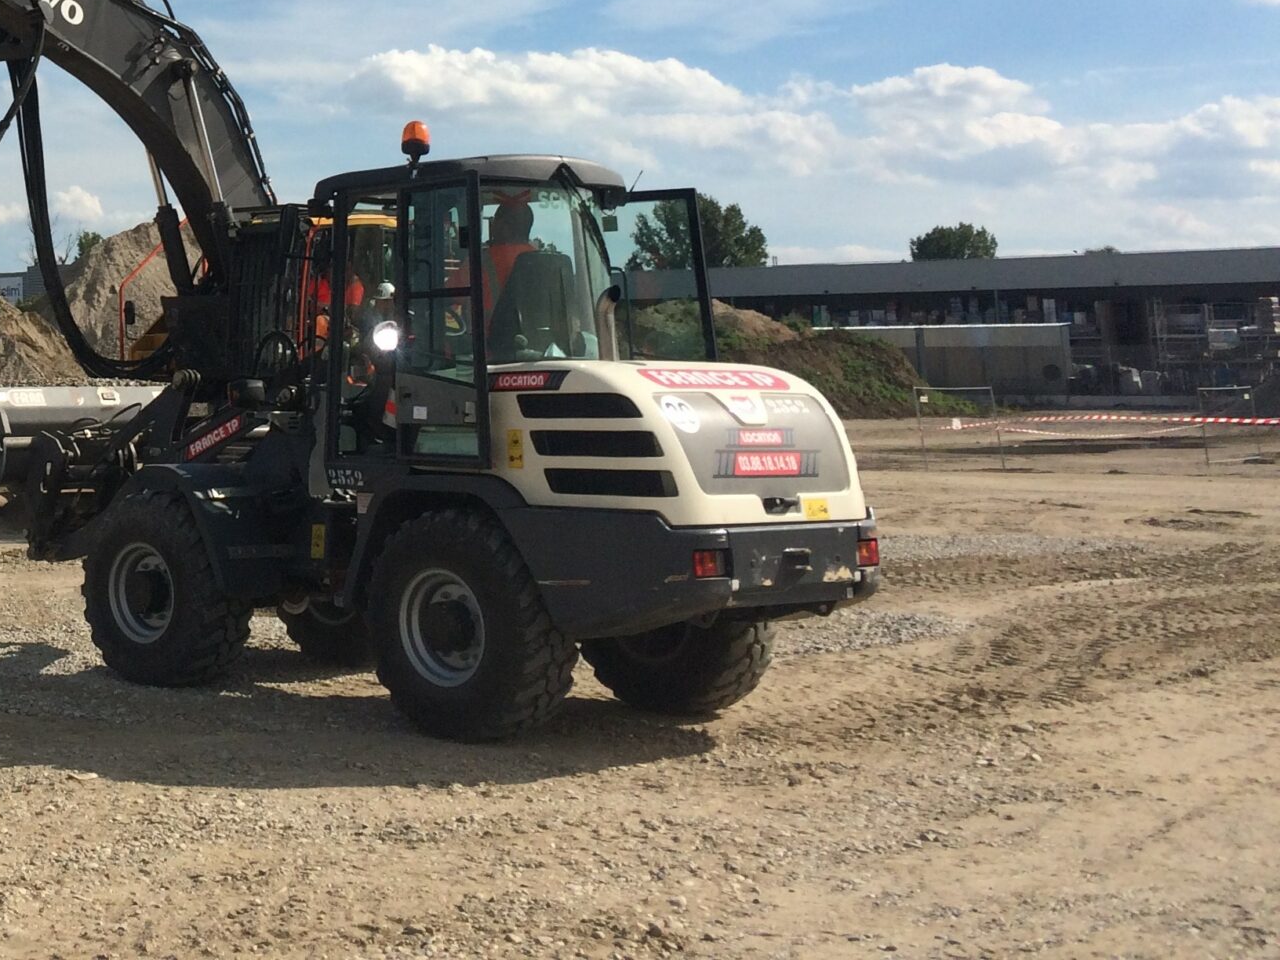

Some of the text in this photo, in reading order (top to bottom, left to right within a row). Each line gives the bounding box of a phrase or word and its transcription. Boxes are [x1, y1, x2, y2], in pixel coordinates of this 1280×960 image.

[498, 375, 544, 387] LOCATION
[647, 370, 776, 387] FRANCE TP
[190, 419, 239, 456] FRANCE TP
[740, 431, 782, 444] LOCATION
